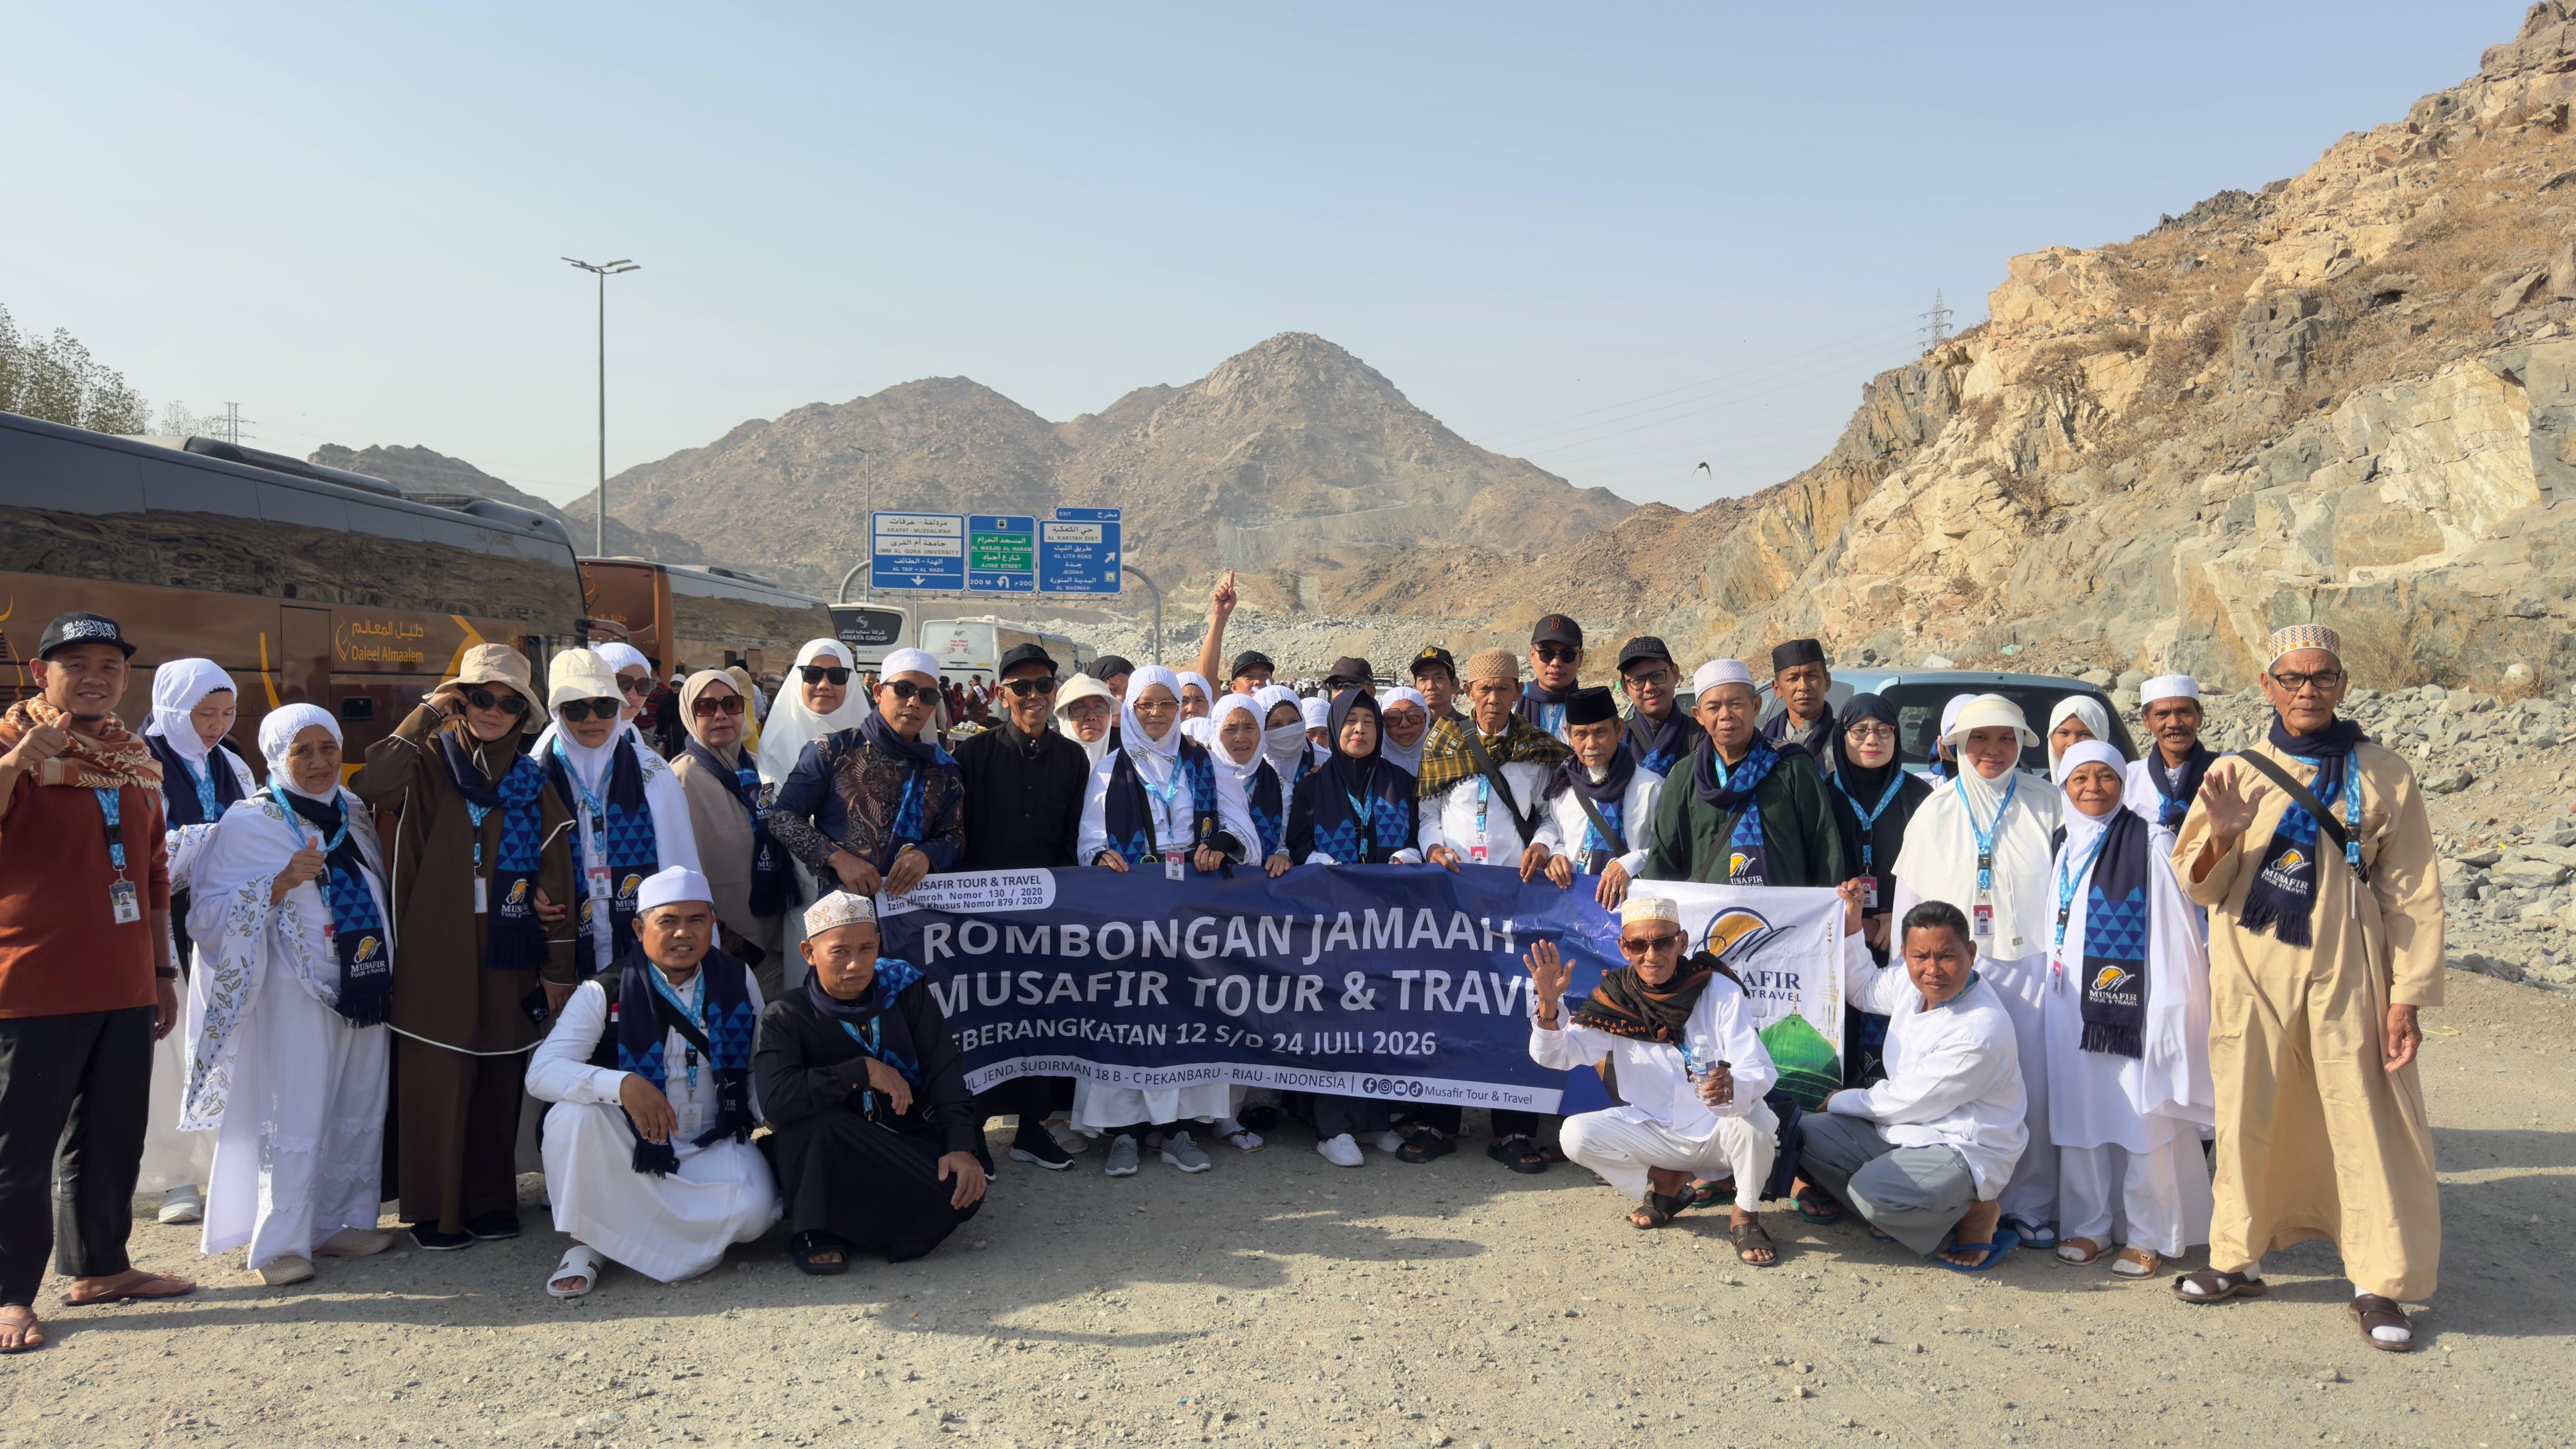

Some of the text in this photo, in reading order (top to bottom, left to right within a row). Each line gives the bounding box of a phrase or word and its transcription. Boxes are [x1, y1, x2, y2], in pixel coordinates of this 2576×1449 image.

[352, 619, 424, 641] دليل المعالم
[352, 645, 424, 663] Daleel Almaalem
[912, 875, 1042, 890] USAFIR TOUR & TRAVEL
[1730, 876, 1763, 885] USAFIR
[2261, 873, 2278, 886] TOUR
[2282, 884, 2307, 895] TRAVEL
[2263, 867, 2308, 889] MUSAFIR
[910, 893, 942, 902] Umroh
[950, 891, 982, 900] Nomor
[989, 889, 1004, 897] 130
[1021, 887, 1042, 896] 2020
[887, 902, 905, 911] Izin
[927, 902, 960, 910] Khusus
[964, 900, 994, 908] Nomor
[998, 899, 1013, 907] 879
[1022, 897, 1043, 905] 2020
[923, 907, 1515, 965] ROMBONGAN JAMAAH
[350, 960, 385, 973] MUSAFIR
[1732, 970, 1801, 990] AFIR
[927, 970, 1539, 1019] MUSAFIR TOUR & TRAVE
[1751, 990, 1802, 1002] TRAVEL
[2089, 990, 2137, 1001] MUSAFIR
[952, 1017, 1437, 1056] BERANGKATAN 12 S/D 24 JULI 2026
[983, 1064, 1017, 1084] JEND.
[1020, 1061, 1091, 1077] SUDIRMAN
[1095, 1069, 1109, 1081] 18
[1113, 1071, 1121, 1082] B
[1133, 1073, 1142, 1084] C
[1145, 1068, 1220, 1085] PEKANBARU
[1232, 1069, 1263, 1082] RIAU
[1274, 1072, 1346, 1089] INDONESIA
[1425, 1086, 1533, 1104] Musafir Tour & Travel
